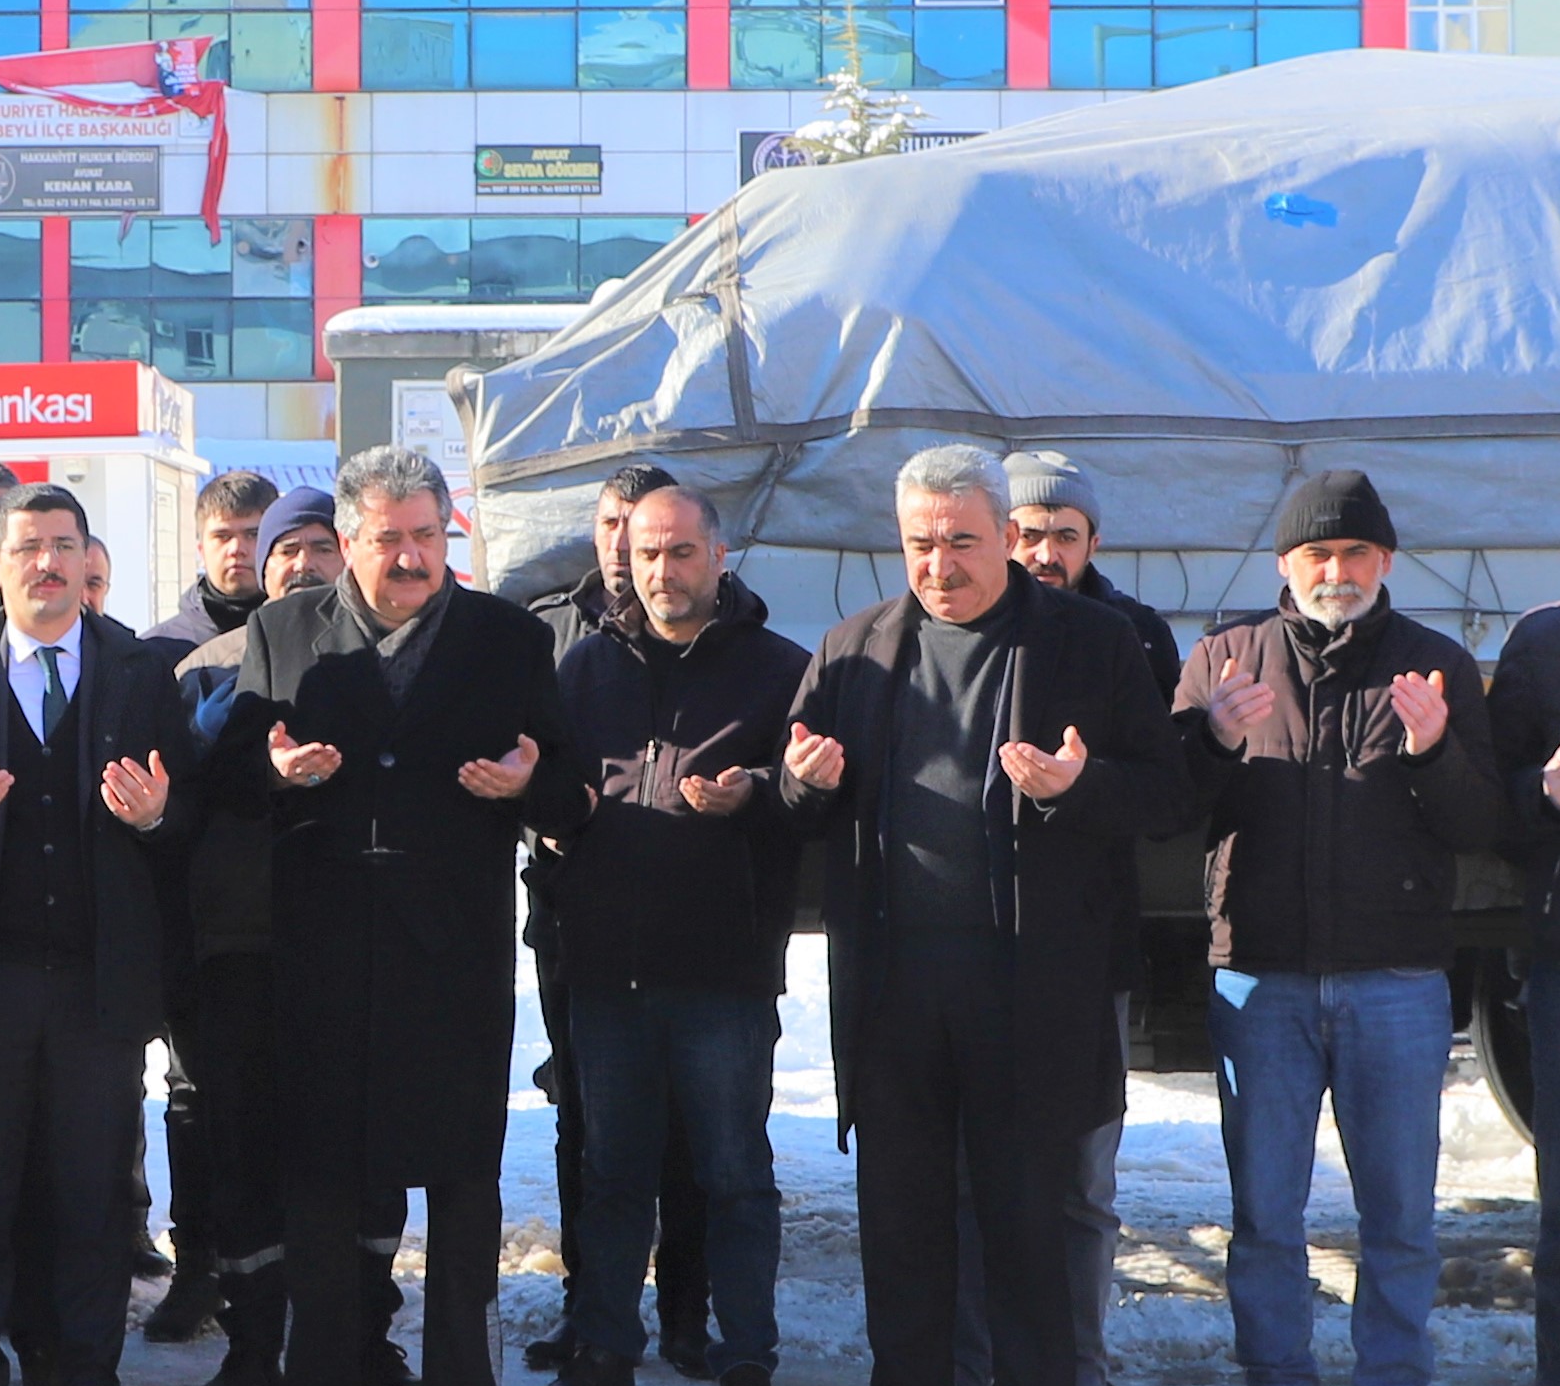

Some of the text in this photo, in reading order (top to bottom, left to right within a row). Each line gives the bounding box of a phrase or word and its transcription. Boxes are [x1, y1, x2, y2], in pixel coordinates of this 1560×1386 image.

[41, 121, 74, 141] İLÇE
[78, 120, 172, 141] BAŞKANLIĞI
[531, 148, 570, 161] AVUKAT
[503, 162, 544, 178] SEVDA
[44, 180, 133, 192] KENAN KARA
